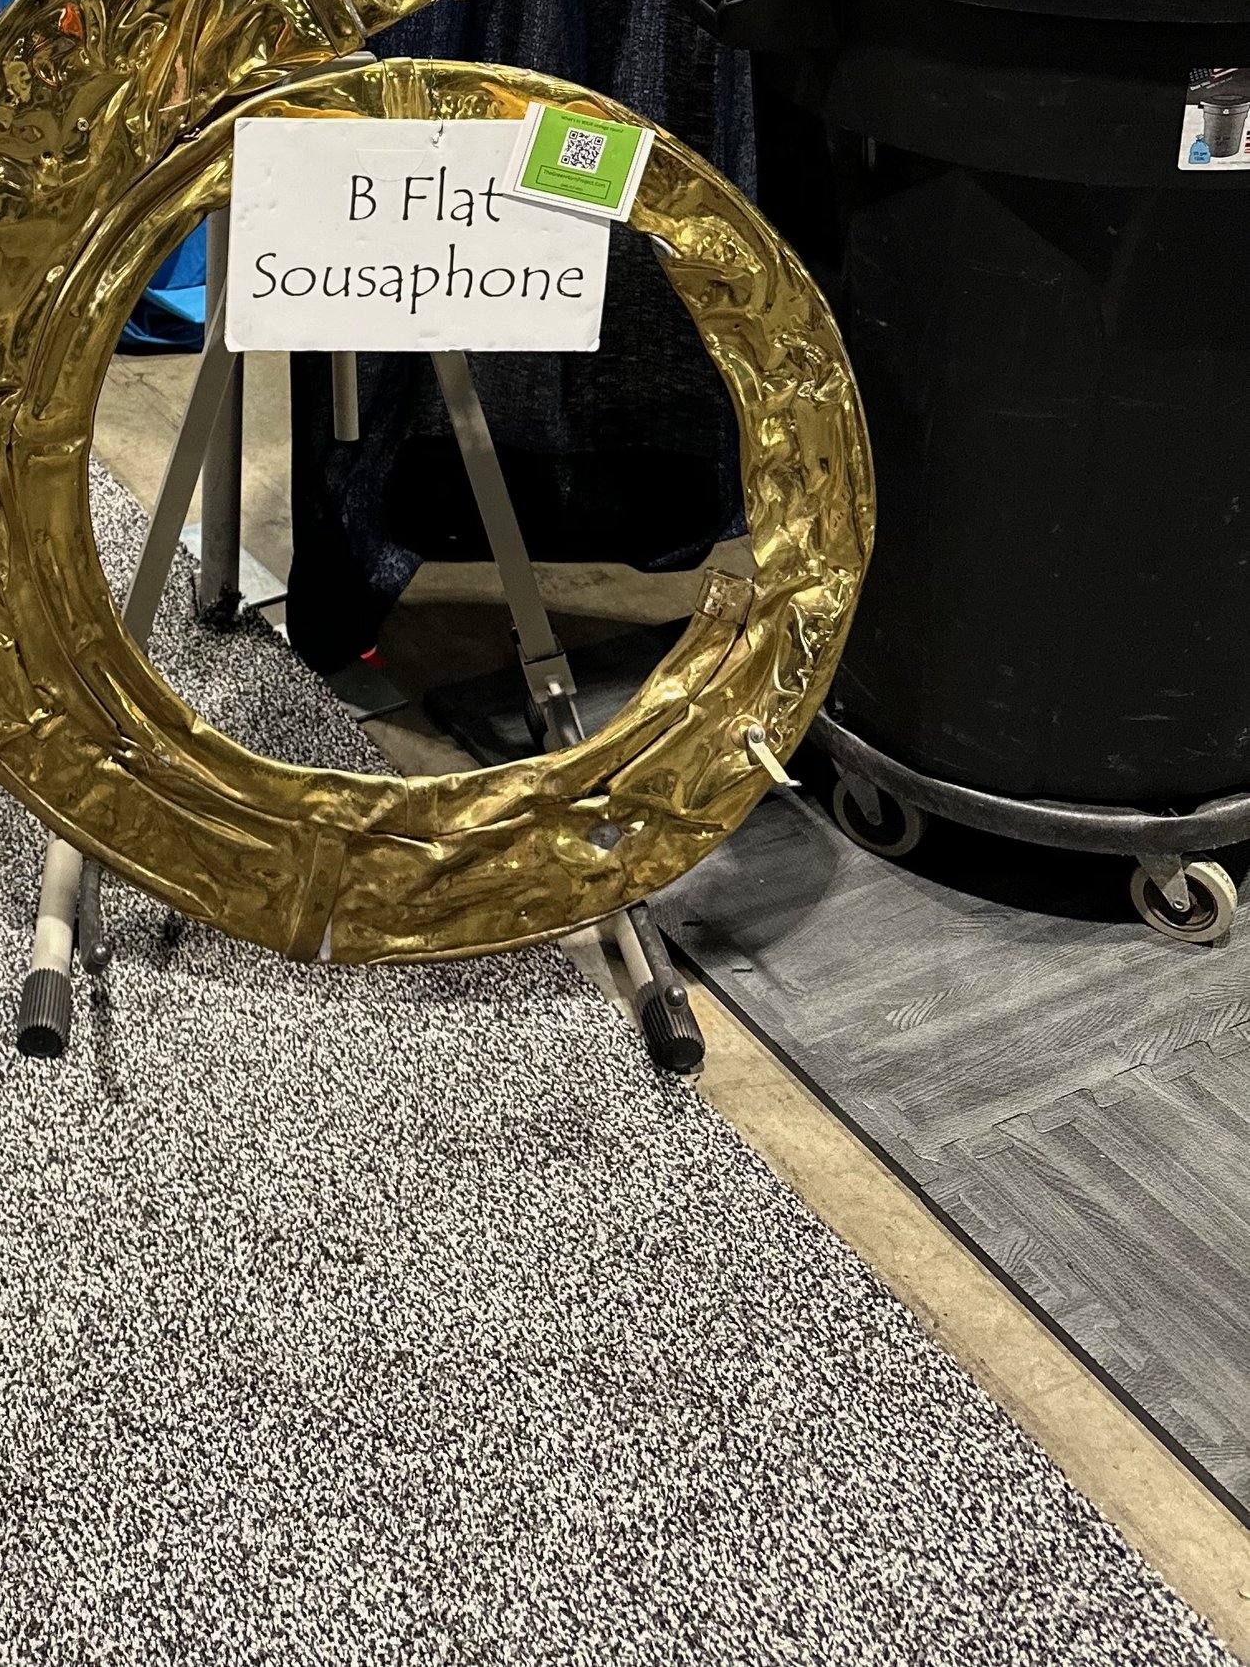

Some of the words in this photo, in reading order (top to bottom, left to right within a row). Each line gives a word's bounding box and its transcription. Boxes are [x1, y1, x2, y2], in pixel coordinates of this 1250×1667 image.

[349, 174, 378, 222] B
[402, 166, 504, 227] Flat
[251, 244, 586, 315] Sousaphone
